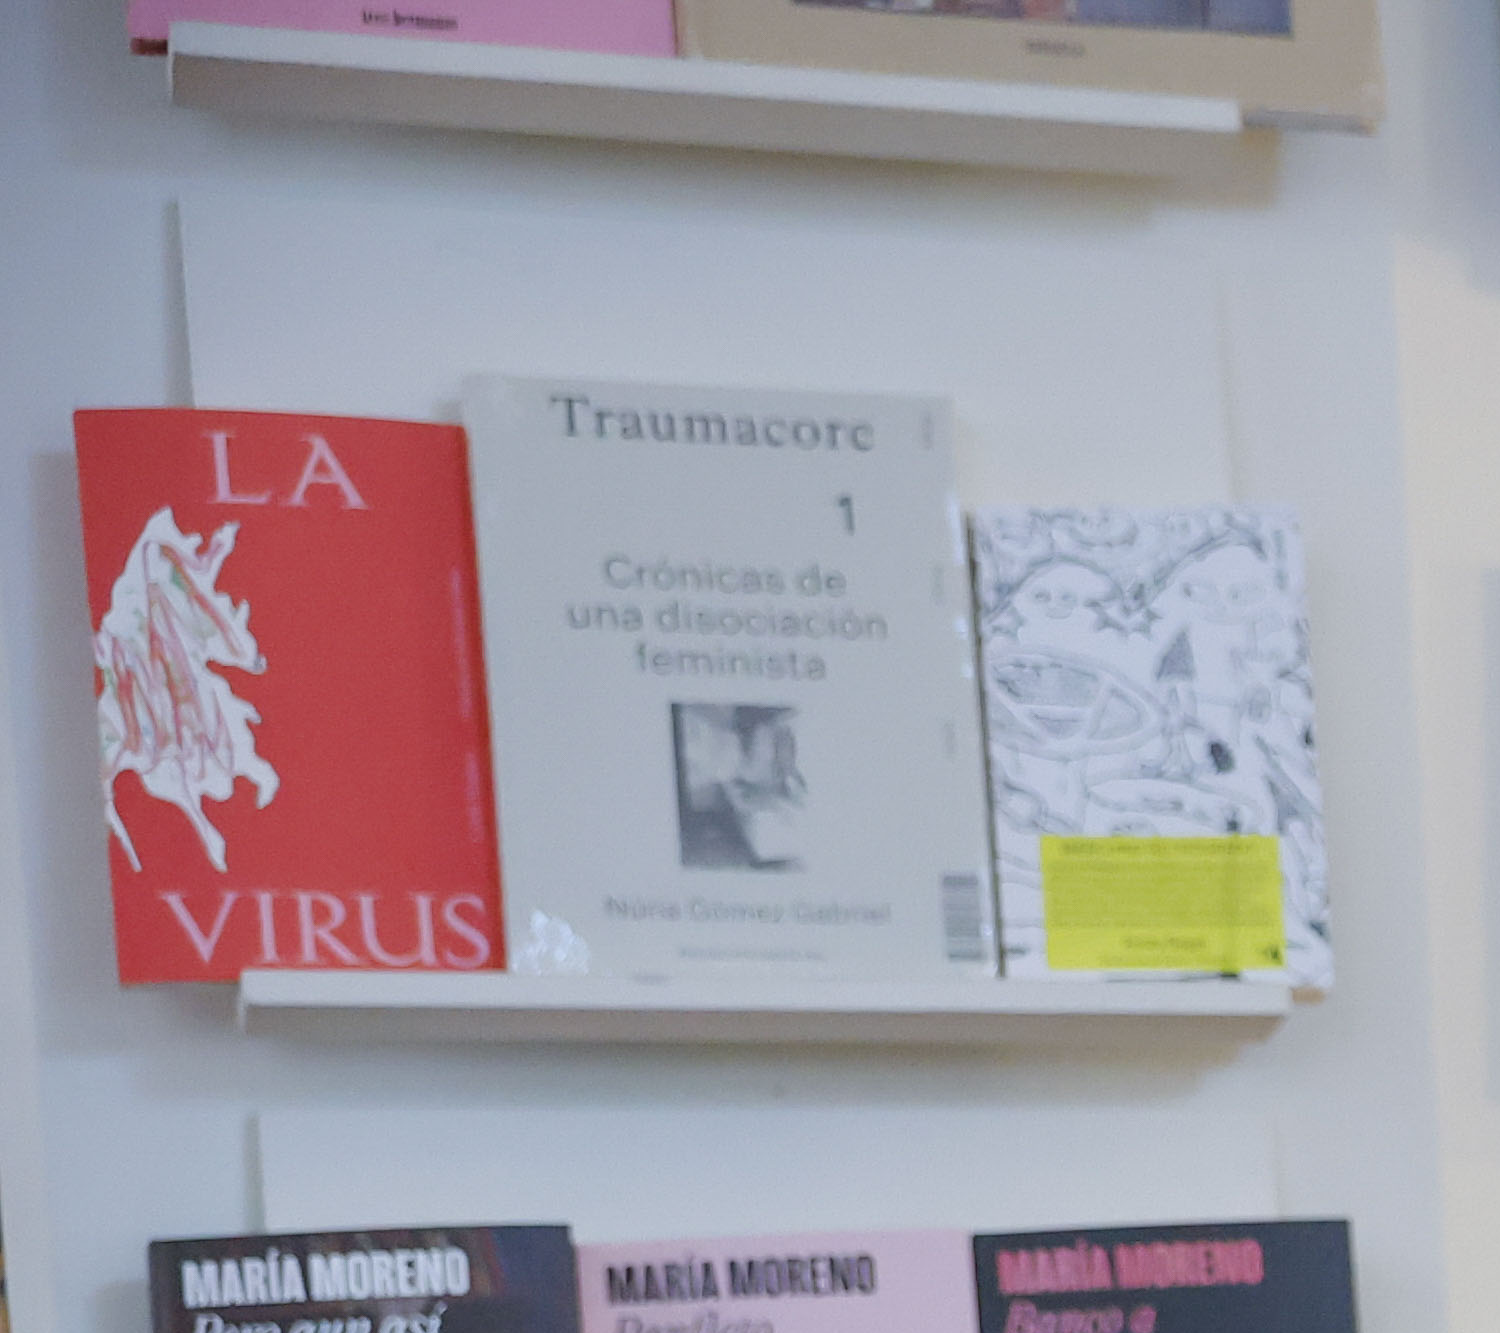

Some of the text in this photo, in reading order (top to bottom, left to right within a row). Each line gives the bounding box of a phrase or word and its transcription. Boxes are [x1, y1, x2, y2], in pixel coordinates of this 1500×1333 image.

[550, 395, 876, 452] Traumacore
[207, 428, 369, 511] LA
[837, 494, 857, 536] 1
[604, 553, 847, 598] Crónicas de
[567, 602, 889, 641] una disociación
[635, 642, 828, 682] feminista
[161, 889, 491, 969] VIRUS
[181, 1245, 471, 1309] MARÍA MORENO
[607, 1253, 879, 1304] MARÍA MORENO
[1113, 1238, 1265, 1289] MORENO
